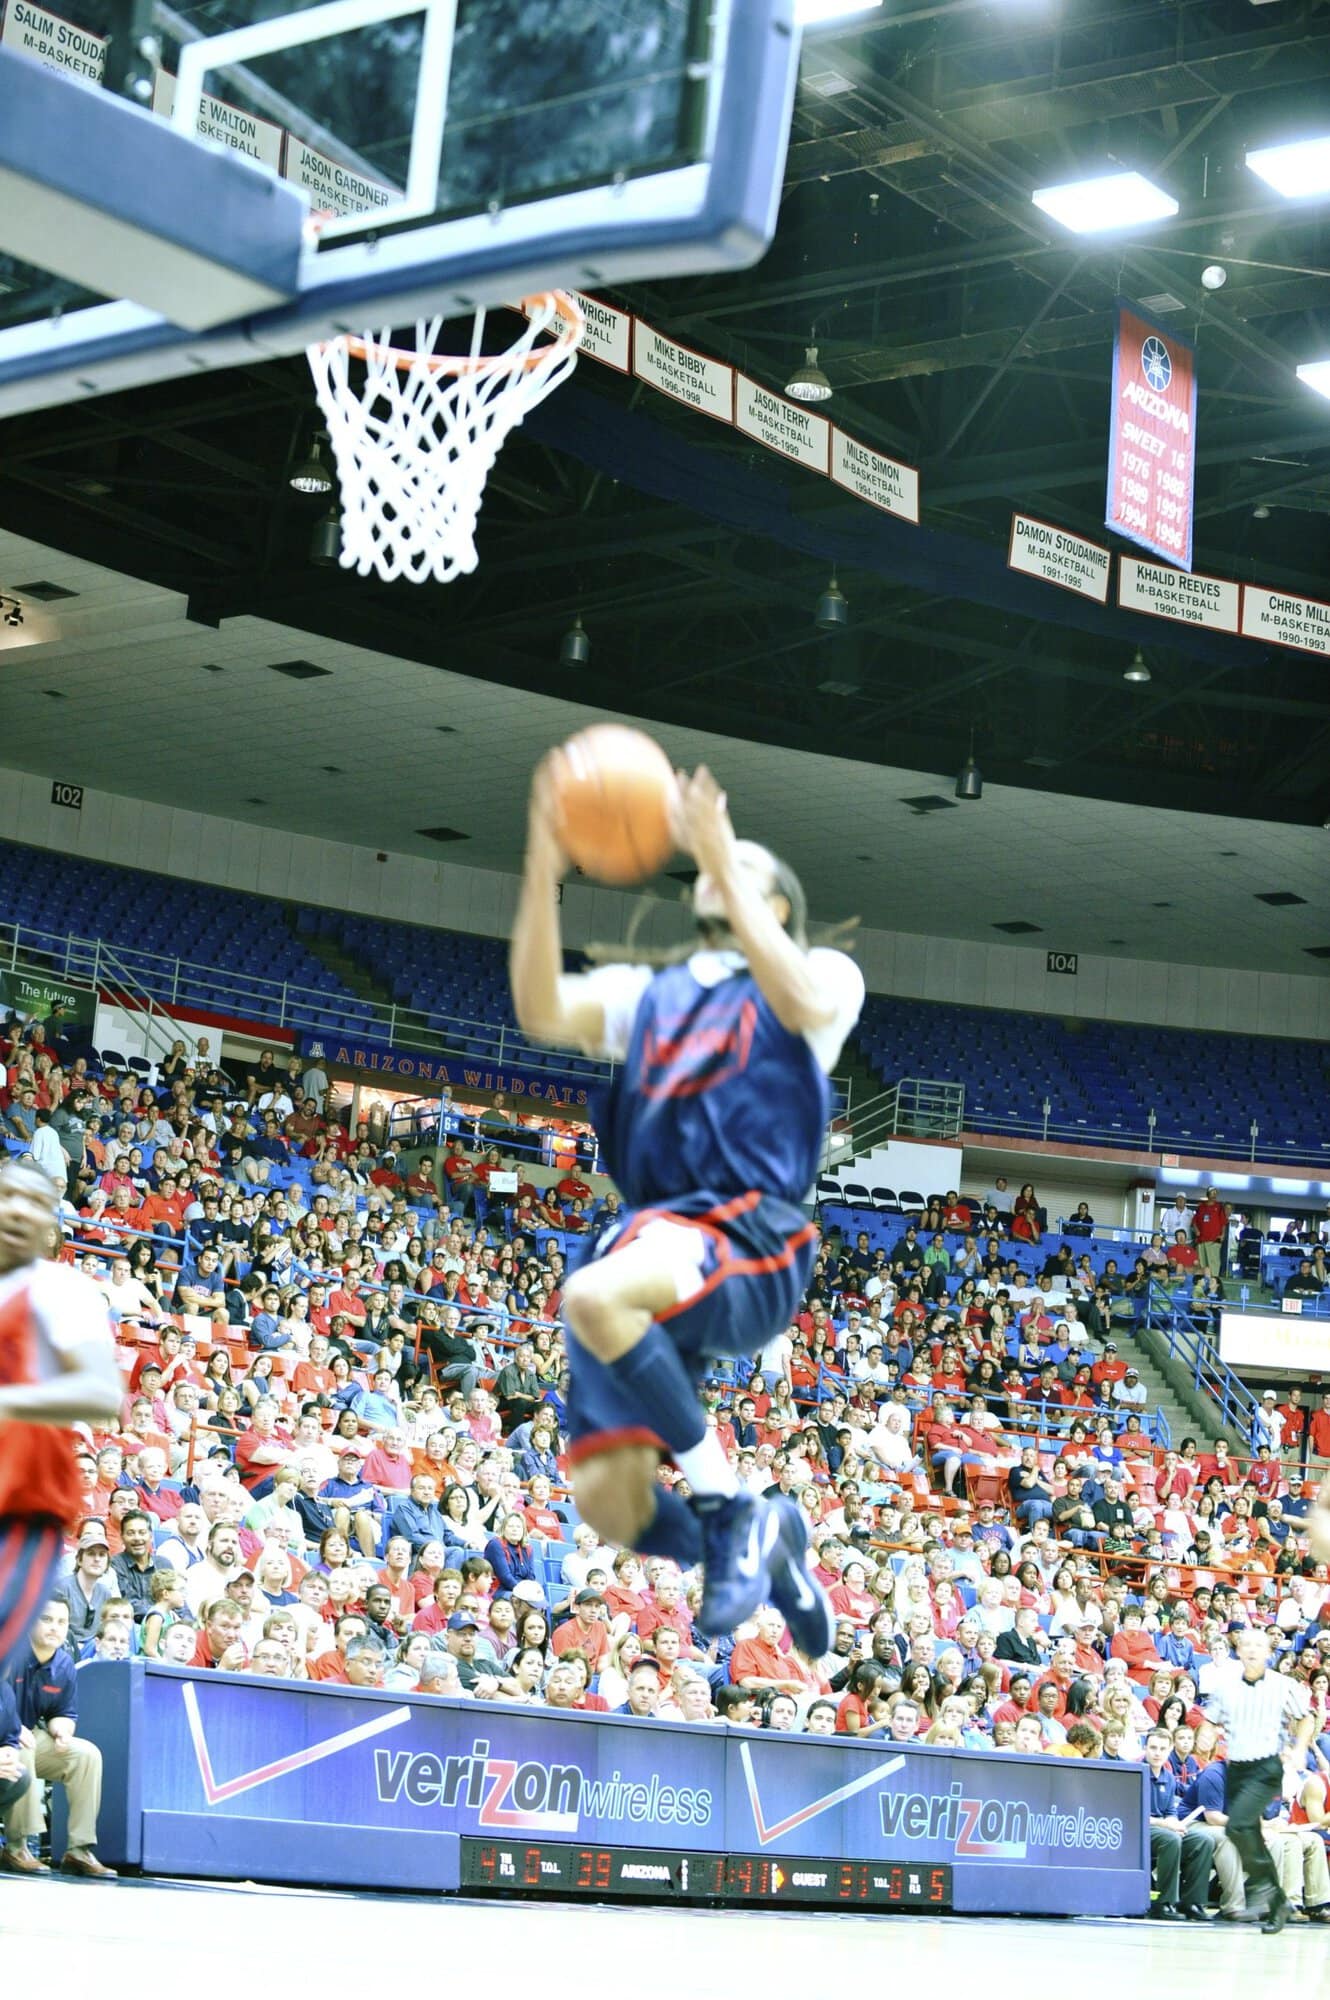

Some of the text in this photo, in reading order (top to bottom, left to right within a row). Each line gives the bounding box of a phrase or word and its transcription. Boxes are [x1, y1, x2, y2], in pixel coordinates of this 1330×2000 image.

[14, 4, 105, 64] SALIM STOUDA
[210, 102, 256, 138] WALTON
[197, 121, 261, 159] SKETBALL
[300, 148, 388, 206] JASON GARDNER
[578, 297, 616, 330] WRIGHT
[647, 352, 716, 396] M-BASKETBALL
[654, 336, 706, 376] MIKE BIBBY
[660, 376, 701, 405] 1996-1998
[1121, 380, 1189, 435] ARIZONA
[748, 404, 814, 448] M-BASKETBALL
[754, 388, 809, 431] JASON TERRY
[761, 428, 799, 456] 1995-1999
[1121, 422, 1186, 471] SWEET 16
[842, 458, 904, 499] M-BASKETBALL
[846, 440, 900, 482] MILES SIMON
[1121, 449, 1150, 480] 1976
[1120, 502, 1184, 550] 1994 1996
[1156, 495, 1184, 524] 1991
[1016, 520, 1108, 569] DAMON STOUDAMIRE
[1027, 543, 1095, 579] M-BASKETBALL
[1042, 564, 1082, 588] 1991-1995
[1137, 564, 1221, 597] KHALID REEVES
[1136, 583, 1220, 612] M-BASKETBALL
[1154, 601, 1203, 621] 1990-1994
[1268, 595, 1302, 616] CHRIS
[1278, 631, 1326, 651] 1990-1993
[55, 784, 81, 806] 102
[1049, 953, 1076, 972] 104
[20, 981, 40, 998] The
[43, 986, 77, 1006] future
[336, 1047, 450, 1082] ARIZONA
[464, 1069, 588, 1105] WILDCATS
[374, 1739, 712, 1832] verizon wireless
[879, 1782, 1123, 1859] verizon wireless
[792, 1872, 828, 1888] GUEST
